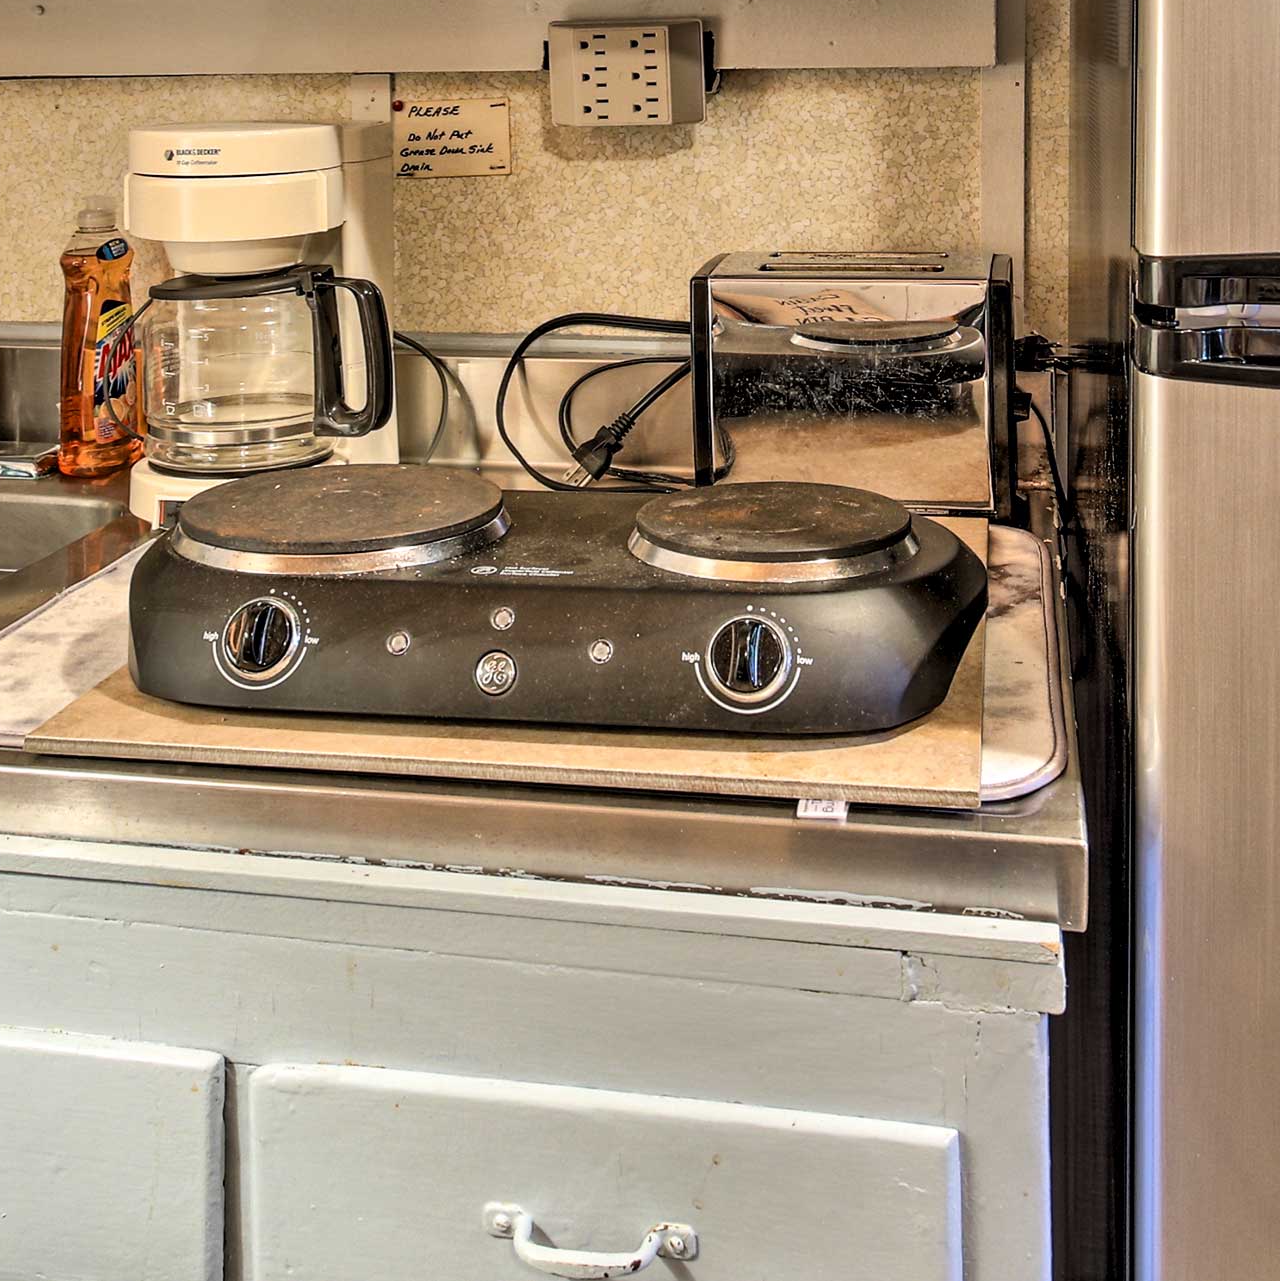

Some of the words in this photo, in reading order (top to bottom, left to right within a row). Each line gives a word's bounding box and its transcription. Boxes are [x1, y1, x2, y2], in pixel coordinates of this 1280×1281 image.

[408, 105, 460, 118] PLEASE
[407, 133, 422, 142] Do
[426, 129, 446, 141] Not
[448, 130, 473, 141] Put
[400, 147, 436, 157] Grease
[439, 146, 466, 156] Down
[469, 143, 494, 155] Sink
[400, 162, 433, 172] Drain
[202, 630, 219, 642] high
[304, 634, 320, 645] low
[681, 651, 700, 663] high
[796, 654, 814, 665] low
